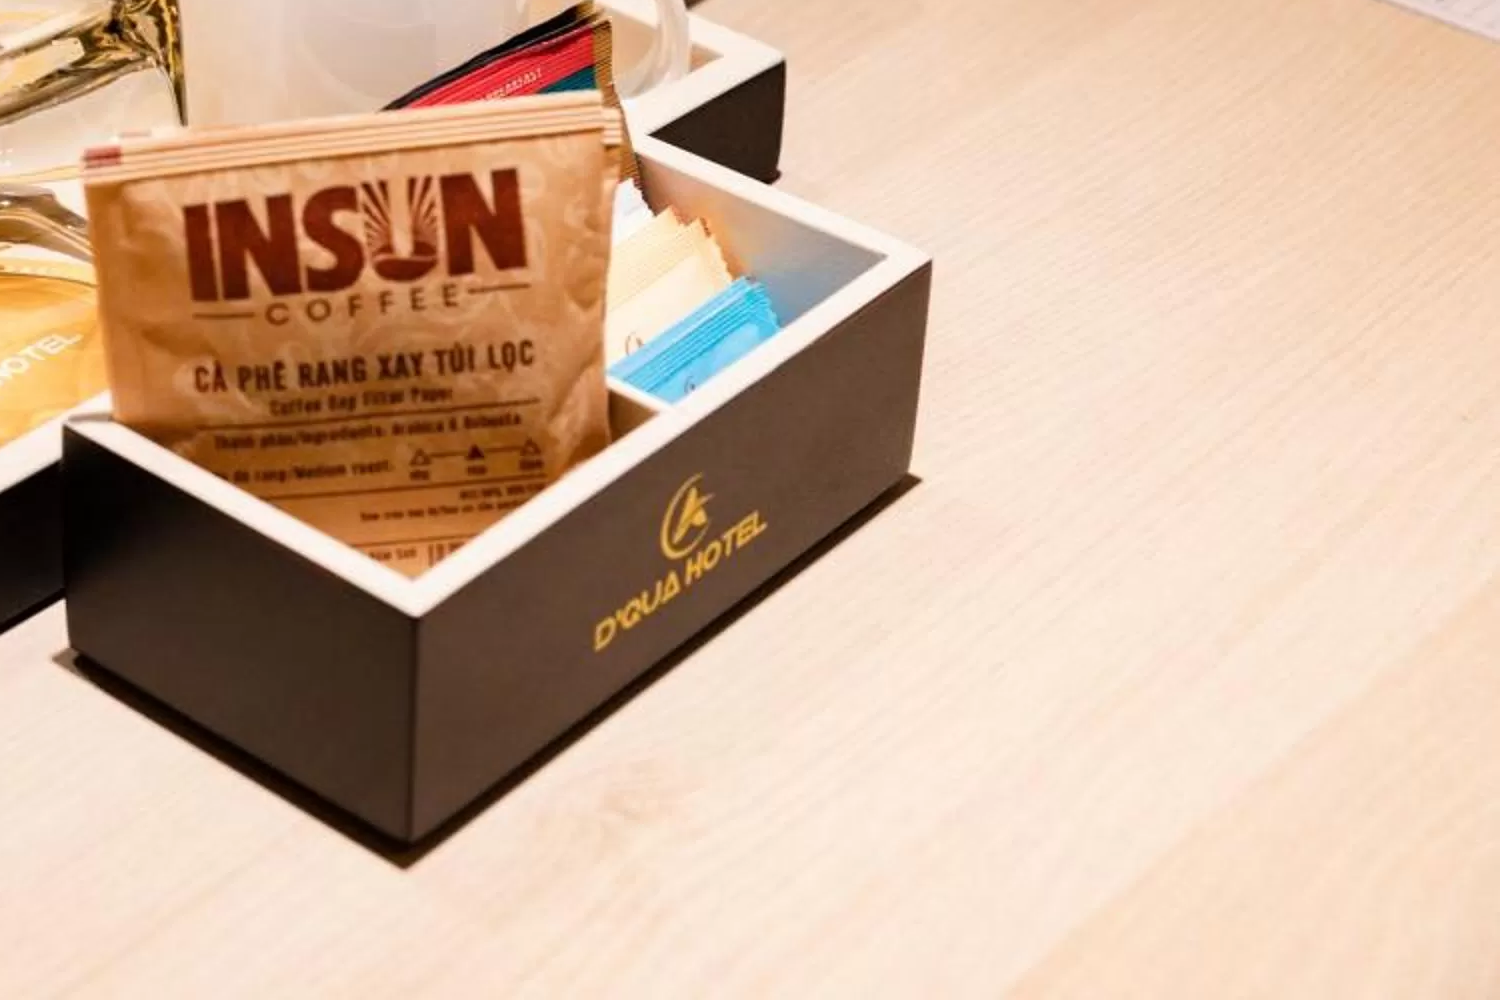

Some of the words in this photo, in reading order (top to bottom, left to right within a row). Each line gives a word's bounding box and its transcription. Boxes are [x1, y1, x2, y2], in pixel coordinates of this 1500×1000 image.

[183, 168, 528, 302] INSUN
[265, 283, 459, 326] COFFEE
[194, 356, 229, 394] CÀ
[237, 358, 288, 394] PHÊ
[296, 355, 367, 389] RANG
[377, 349, 425, 382] XAY
[488, 338, 535, 374] LỌC
[684, 509, 768, 586] HOTEL
